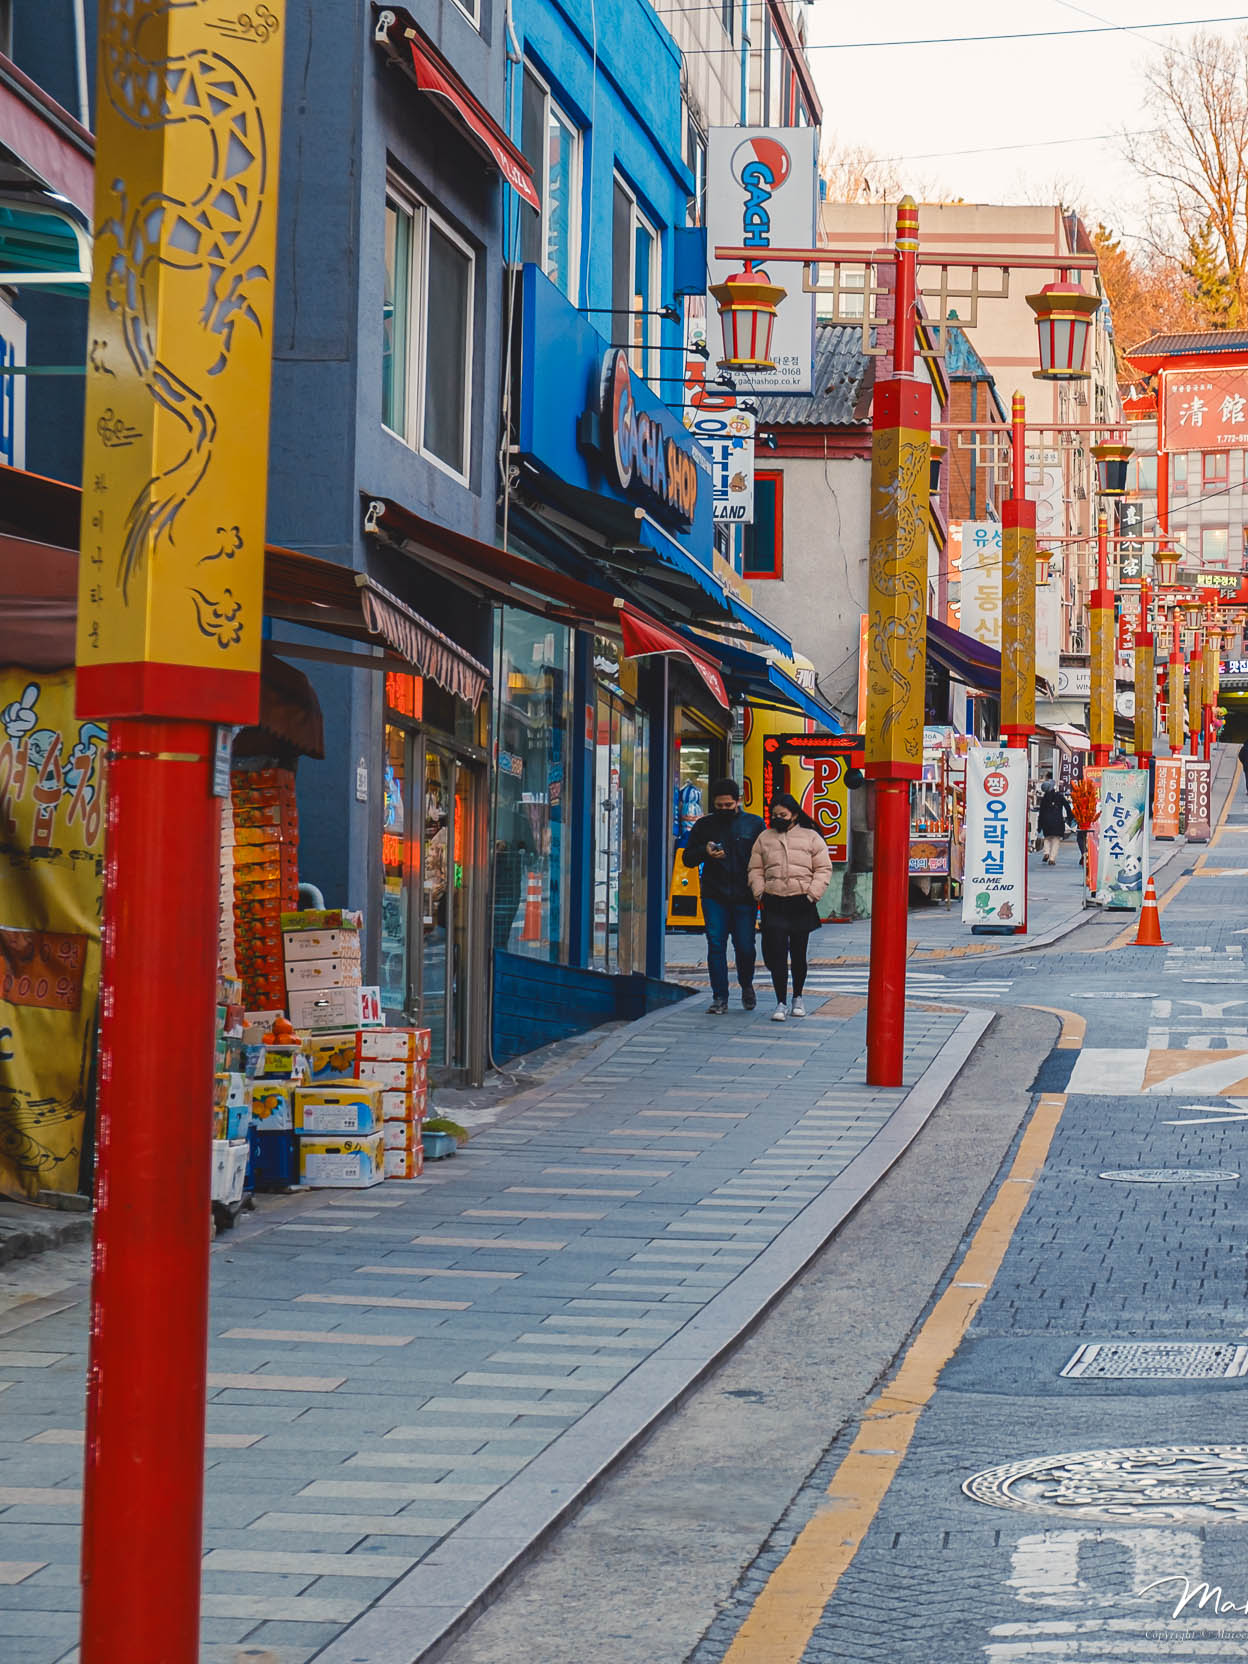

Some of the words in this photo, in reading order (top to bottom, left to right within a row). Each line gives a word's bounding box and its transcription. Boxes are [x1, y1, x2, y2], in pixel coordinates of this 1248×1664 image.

[741, 160, 775, 269] GACH
[665, 437, 697, 525] SHOP
[987, 776, 1006, 794] 짱
[1187, 770, 1199, 824] 아메리카노
[1198, 769, 1209, 817] 2,000
[981, 800, 1009, 875] 오락실
[1103, 791, 1131, 860] 사탕수수
